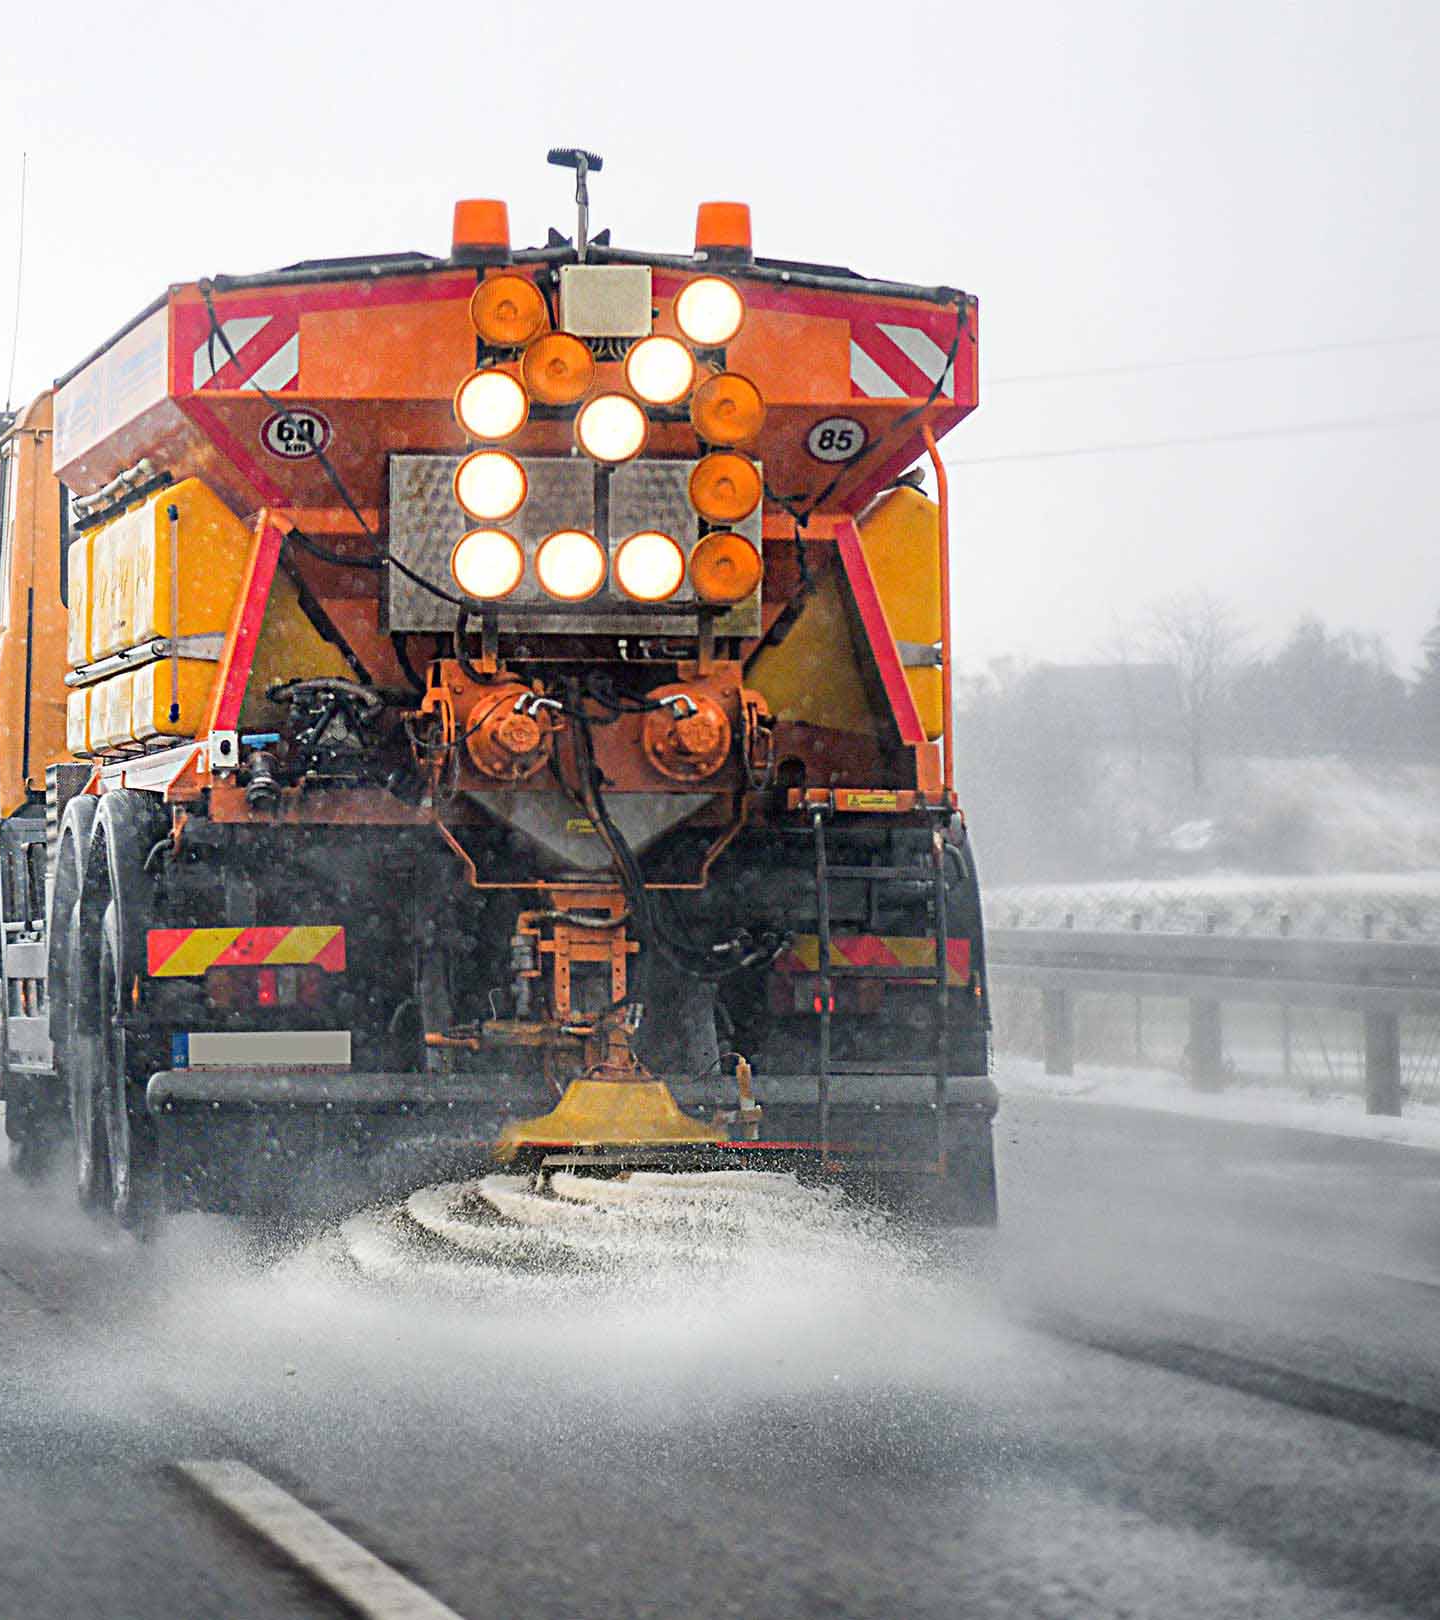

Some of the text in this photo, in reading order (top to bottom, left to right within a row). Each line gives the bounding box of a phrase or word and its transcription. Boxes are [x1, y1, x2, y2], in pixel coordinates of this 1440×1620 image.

[277, 419, 315, 441] 60
[819, 429, 853, 451] 85
[285, 441, 306, 452] km
